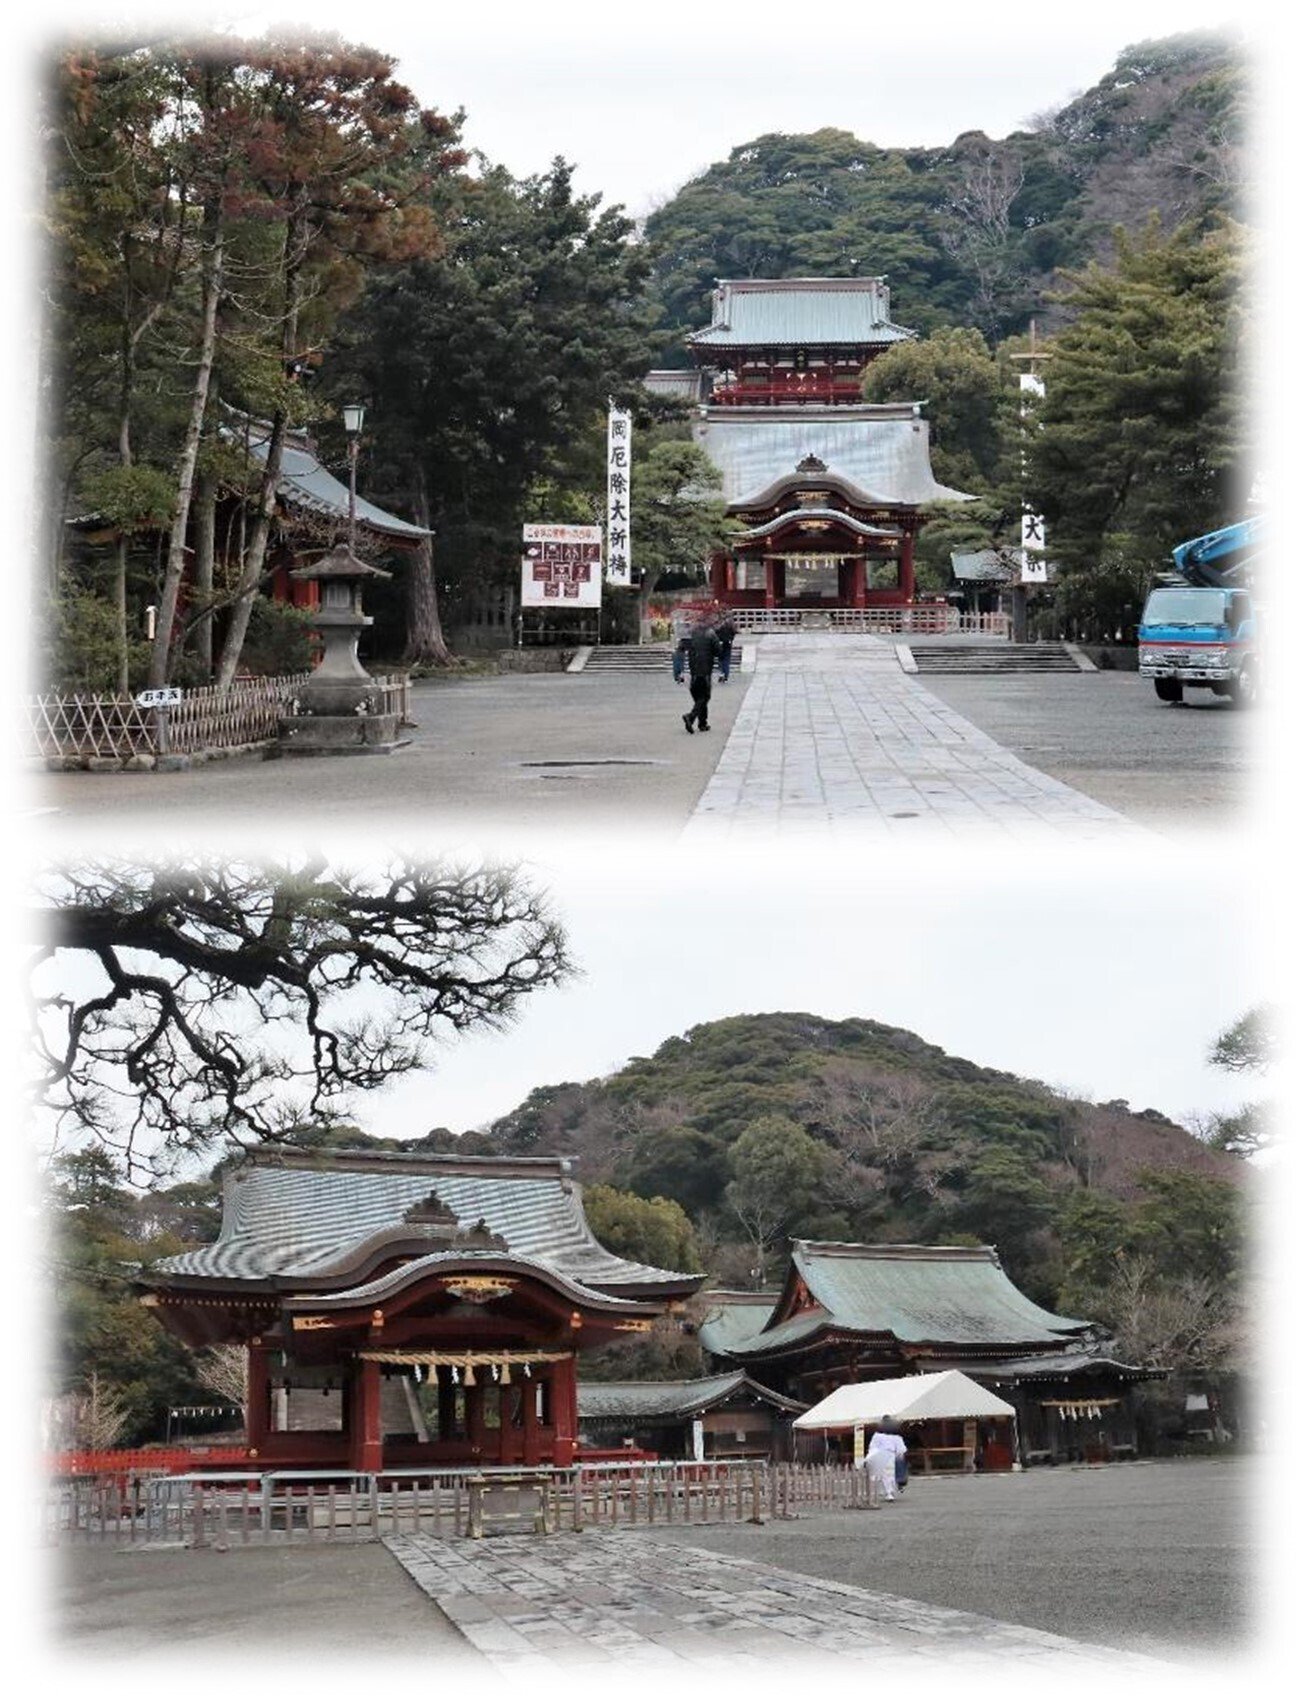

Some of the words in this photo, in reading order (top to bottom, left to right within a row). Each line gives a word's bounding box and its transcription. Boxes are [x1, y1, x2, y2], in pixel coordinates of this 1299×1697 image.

[609, 403, 628, 577] 岡厄除大祈祷
